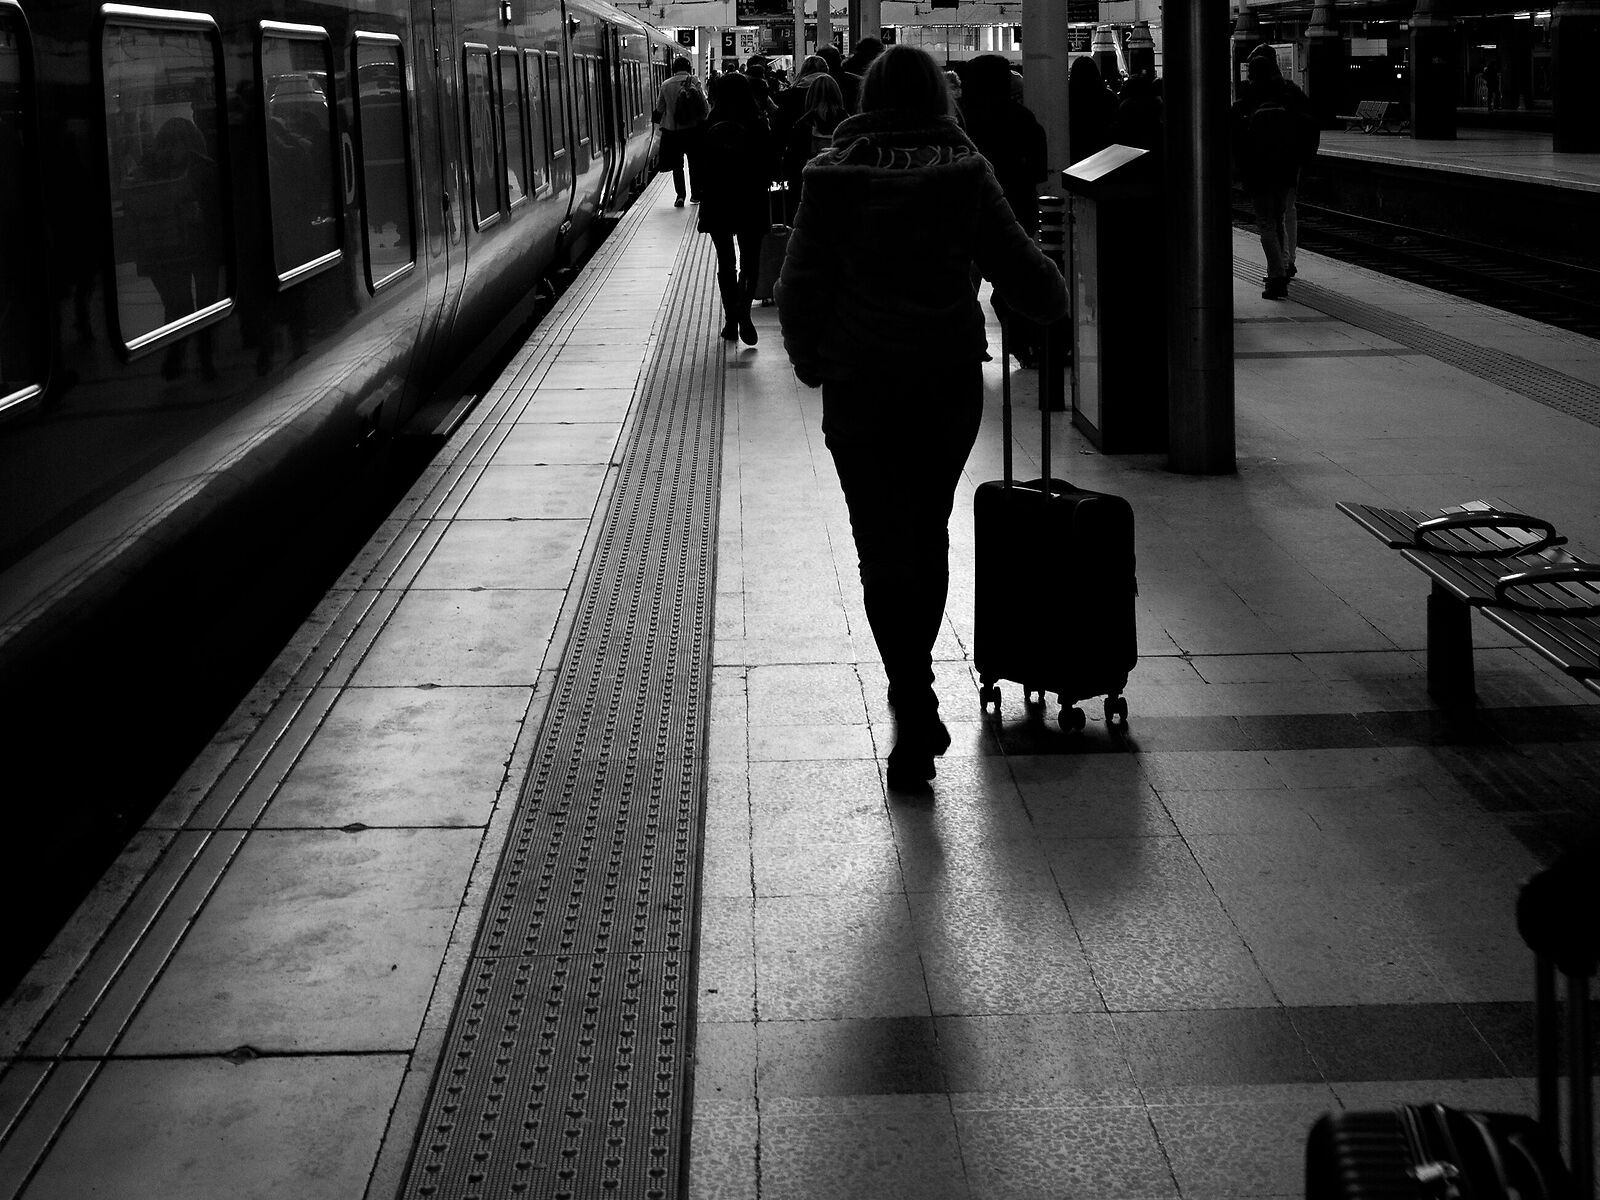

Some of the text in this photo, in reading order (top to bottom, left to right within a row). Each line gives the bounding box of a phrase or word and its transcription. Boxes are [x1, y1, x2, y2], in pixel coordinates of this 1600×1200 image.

[683, 32, 691, 44] 5
[725, 35, 733, 47] 5
[833, 34, 841, 45] 4
[883, 29, 892, 41] 4
[1125, 31, 1132, 42] 2
[341, 132, 356, 205] D
